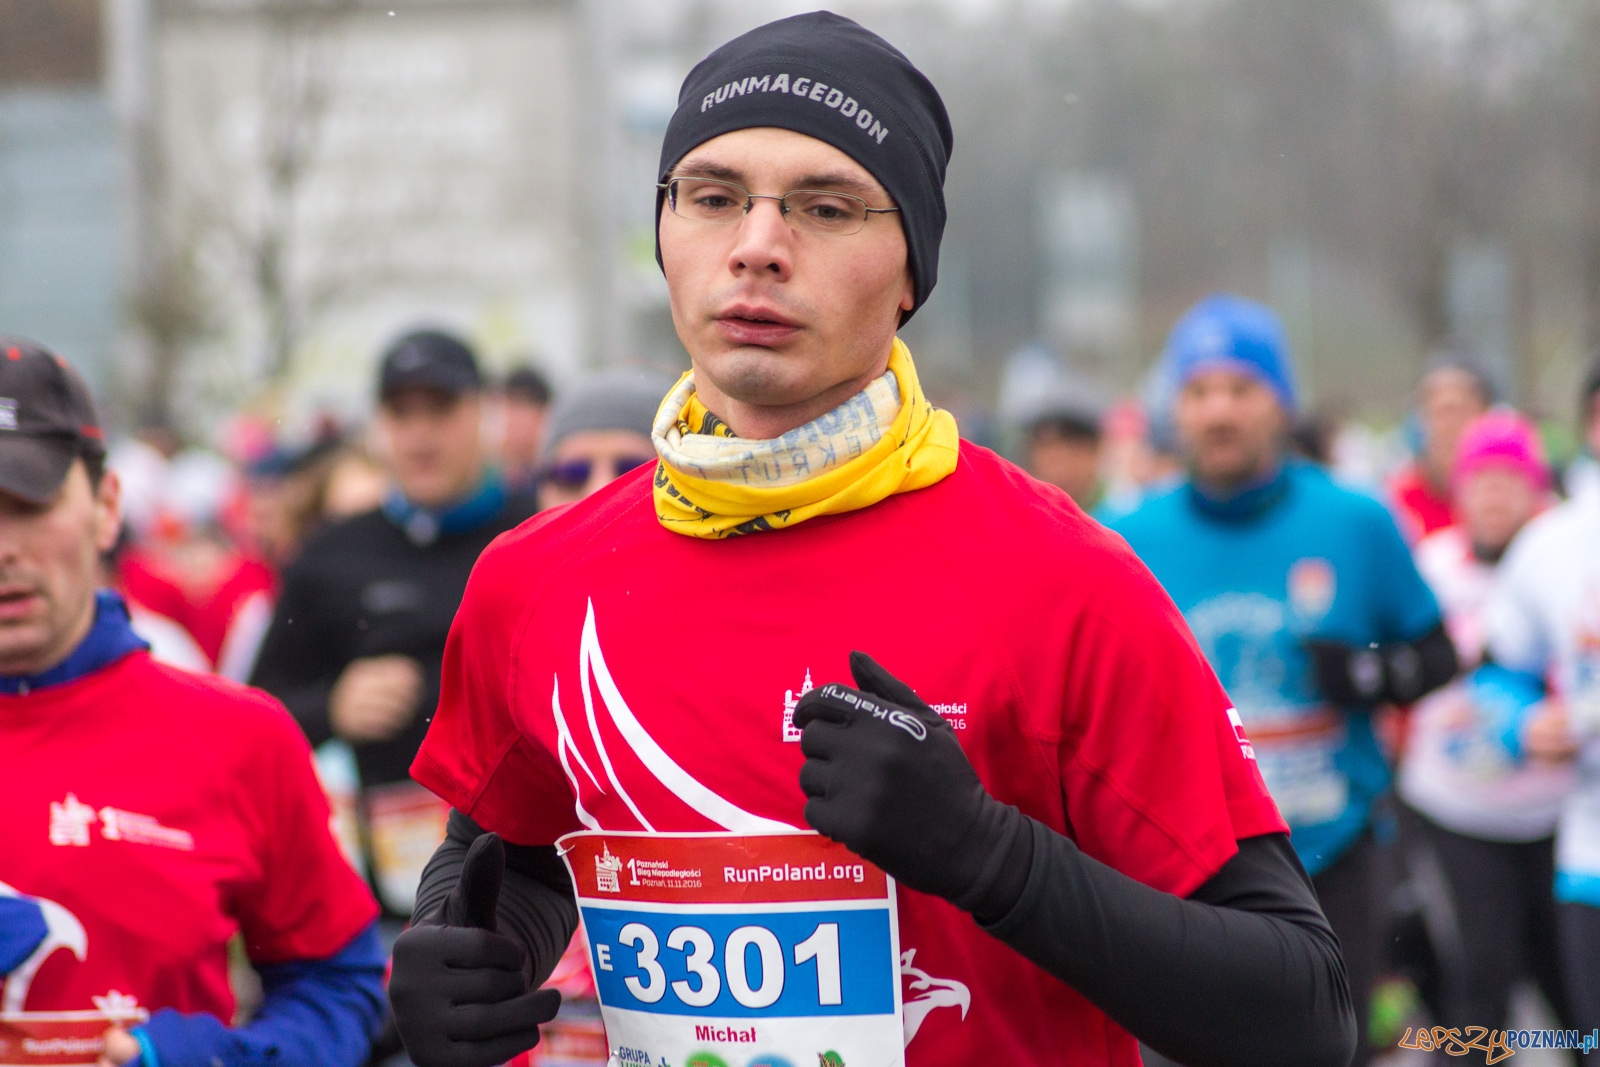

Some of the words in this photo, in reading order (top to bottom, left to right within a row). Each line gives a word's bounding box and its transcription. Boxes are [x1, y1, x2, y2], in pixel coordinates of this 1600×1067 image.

[700, 73, 890, 145] RUNMAGEDDON
[820, 685, 888, 720] Kalenji
[636, 860, 669, 869] Poznański
[637, 868, 652, 877] Bieg
[723, 862, 865, 884] RunPoland.org
[596, 943, 614, 972] E
[618, 922, 843, 1009] 3301
[694, 1024, 757, 1044] Michał
[618, 1046, 651, 1065] GRUPA
